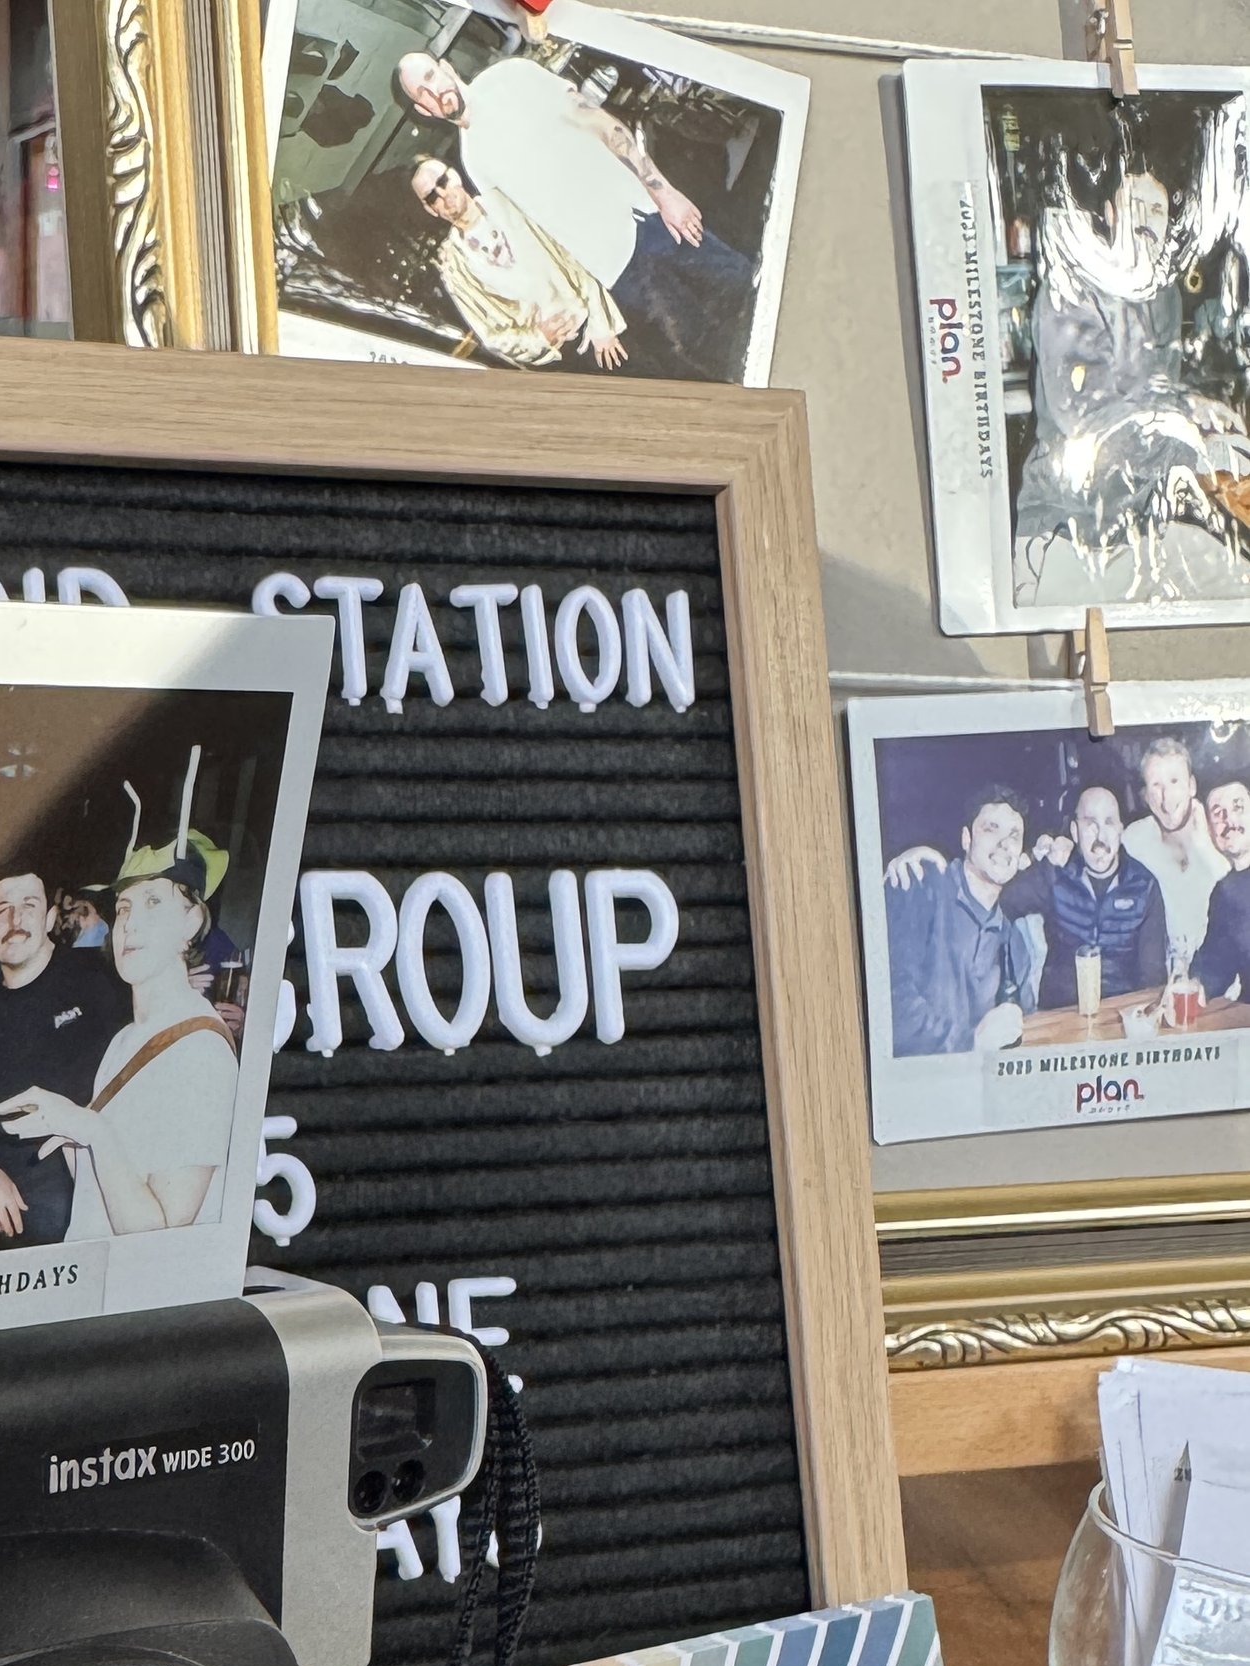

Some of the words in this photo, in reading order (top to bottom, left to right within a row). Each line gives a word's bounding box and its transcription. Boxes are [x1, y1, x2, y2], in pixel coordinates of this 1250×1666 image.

[962, 249, 986, 361] MILESTONE
[973, 369, 994, 479] BIRTHDAYS
[273, 868, 679, 1058] ROUP
[1040, 1052, 1129, 1073] MILESTONE
[1135, 1046, 1221, 1067] BIRTHDAYS
[49, 1446, 158, 1495] instax
[161, 1446, 213, 1474] WIDE
[217, 1439, 256, 1465] 300
